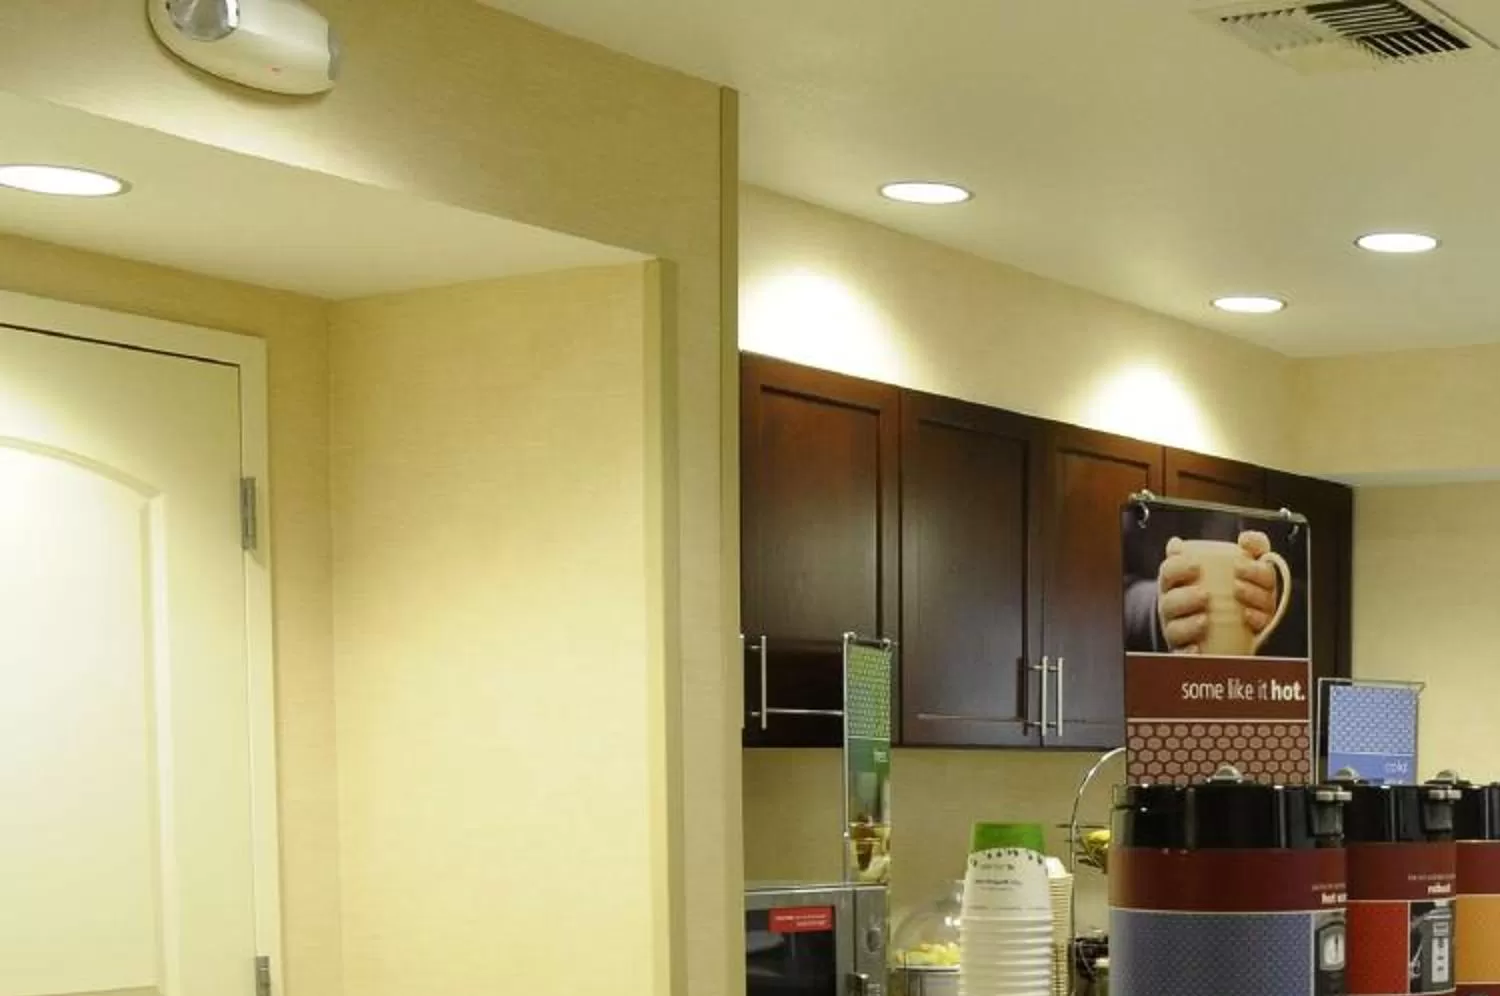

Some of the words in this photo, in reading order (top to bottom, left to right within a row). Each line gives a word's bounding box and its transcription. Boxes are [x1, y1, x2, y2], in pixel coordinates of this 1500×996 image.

[1181, 682, 1225, 699] some
[1227, 678, 1254, 700] like
[1257, 679, 1268, 700] it
[1271, 679, 1305, 700] hot.
